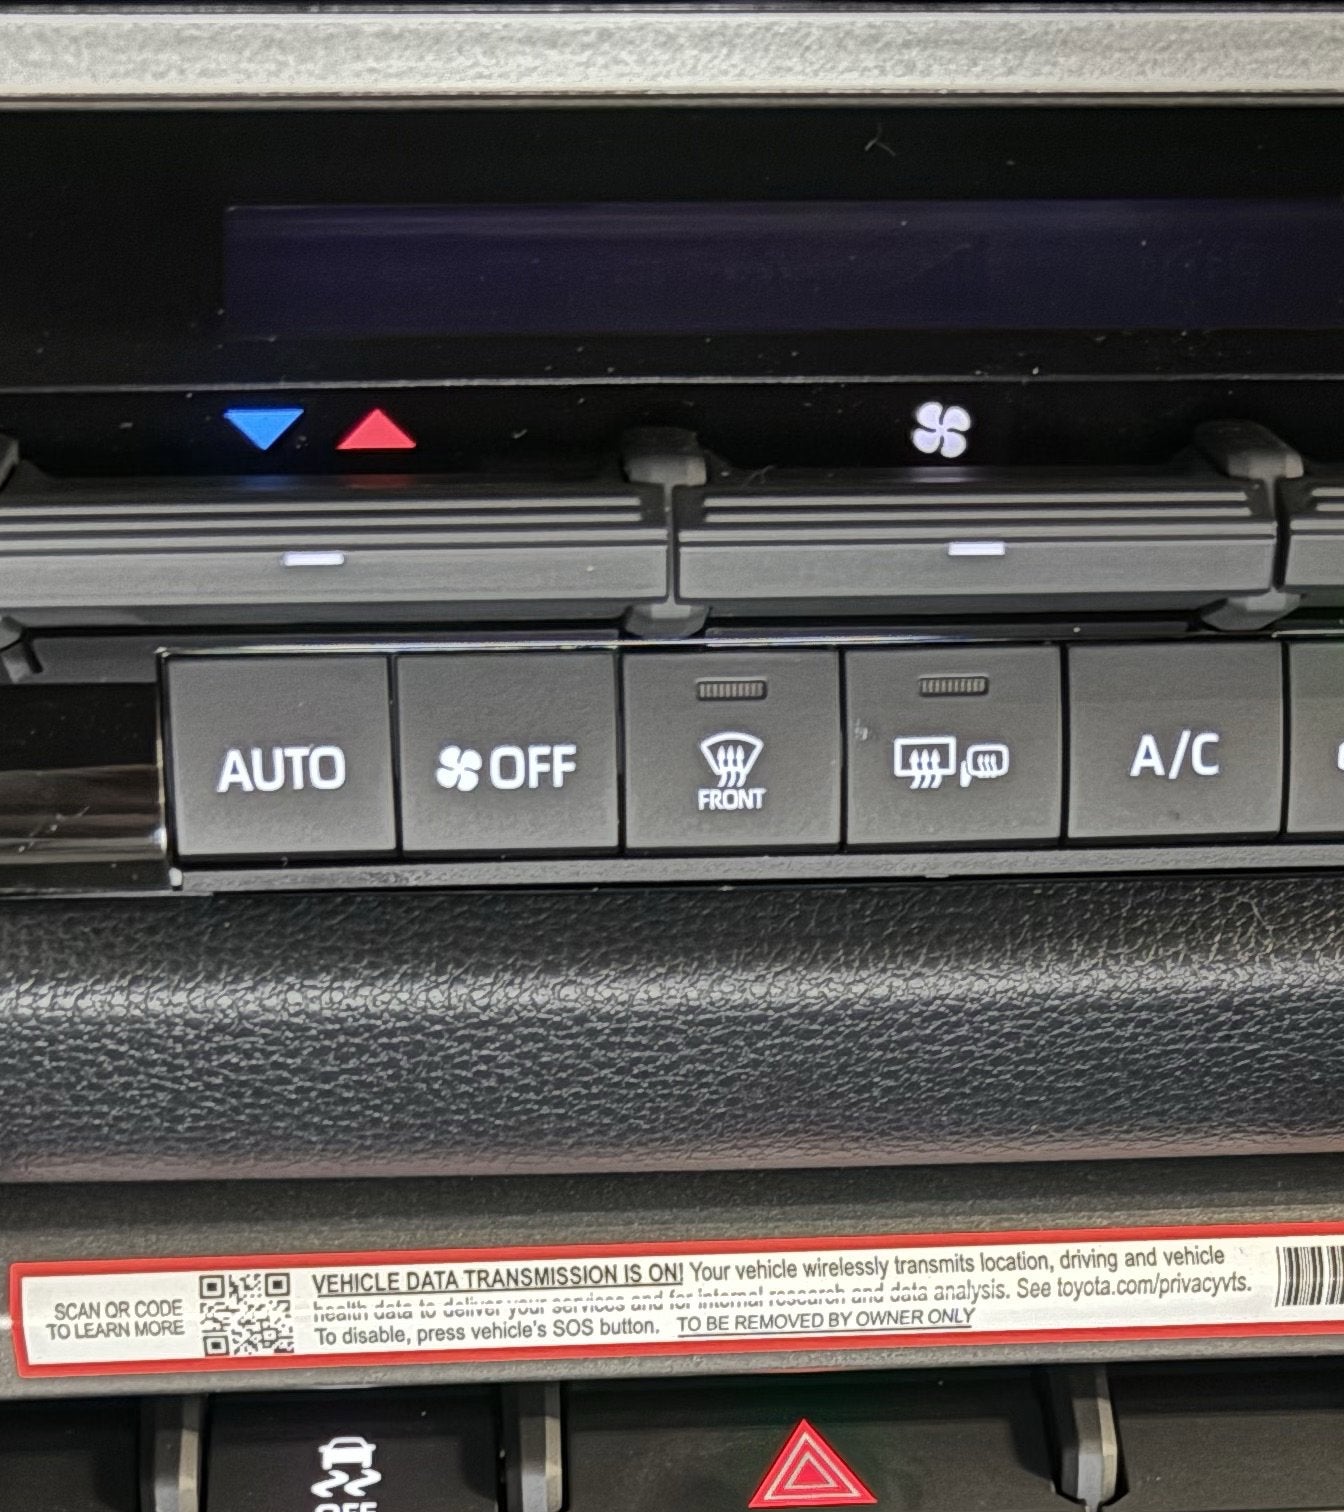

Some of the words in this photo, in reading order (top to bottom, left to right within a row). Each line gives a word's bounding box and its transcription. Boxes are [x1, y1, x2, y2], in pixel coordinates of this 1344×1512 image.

[217, 745, 346, 792] AUTO
[490, 744, 577, 788] OFF
[1130, 730, 1221, 781] A/C
[698, 788, 766, 811] FRONT
[312, 1272, 399, 1293] VEHICLE
[407, 1270, 458, 1290] DATA
[464, 1264, 617, 1288] TRANSMISSION
[624, 1263, 642, 1283] IS
[649, 1262, 684, 1282] ON!
[689, 1261, 730, 1281] Your
[735, 1258, 797, 1280] vehicle
[803, 1256, 889, 1280] wirelessly
[894, 1252, 975, 1275] transmits
[981, 1250, 1054, 1273] location,
[1060, 1248, 1117, 1272] driving
[1125, 1247, 1156, 1267] and
[1163, 1244, 1225, 1266] vehicle
[934, 1278, 1010, 1304] analysis.
[1017, 1277, 1051, 1299] See
[1057, 1271, 1252, 1302] toyota.com/privacyvts.
[54, 1301, 101, 1321] SCAN
[135, 1299, 183, 1318] CODE
[677, 1316, 701, 1333] TO
[707, 1315, 729, 1331] BE
[735, 1312, 824, 1330] REMOVED
[828, 1311, 853, 1328] BY
[856, 1309, 923, 1327] OWNER
[927, 1306, 976, 1325] ONLY
[45, 1323, 71, 1340] TO
[74, 1321, 131, 1339] LEARN
[135, 1319, 185, 1337] MORE
[314, 1328, 337, 1345] To
[342, 1325, 411, 1346] disable,
[417, 1326, 465, 1346] press
[471, 1320, 547, 1341] vehicle's
[552, 1318, 594, 1337] SOS
[600, 1317, 660, 1336] button.
